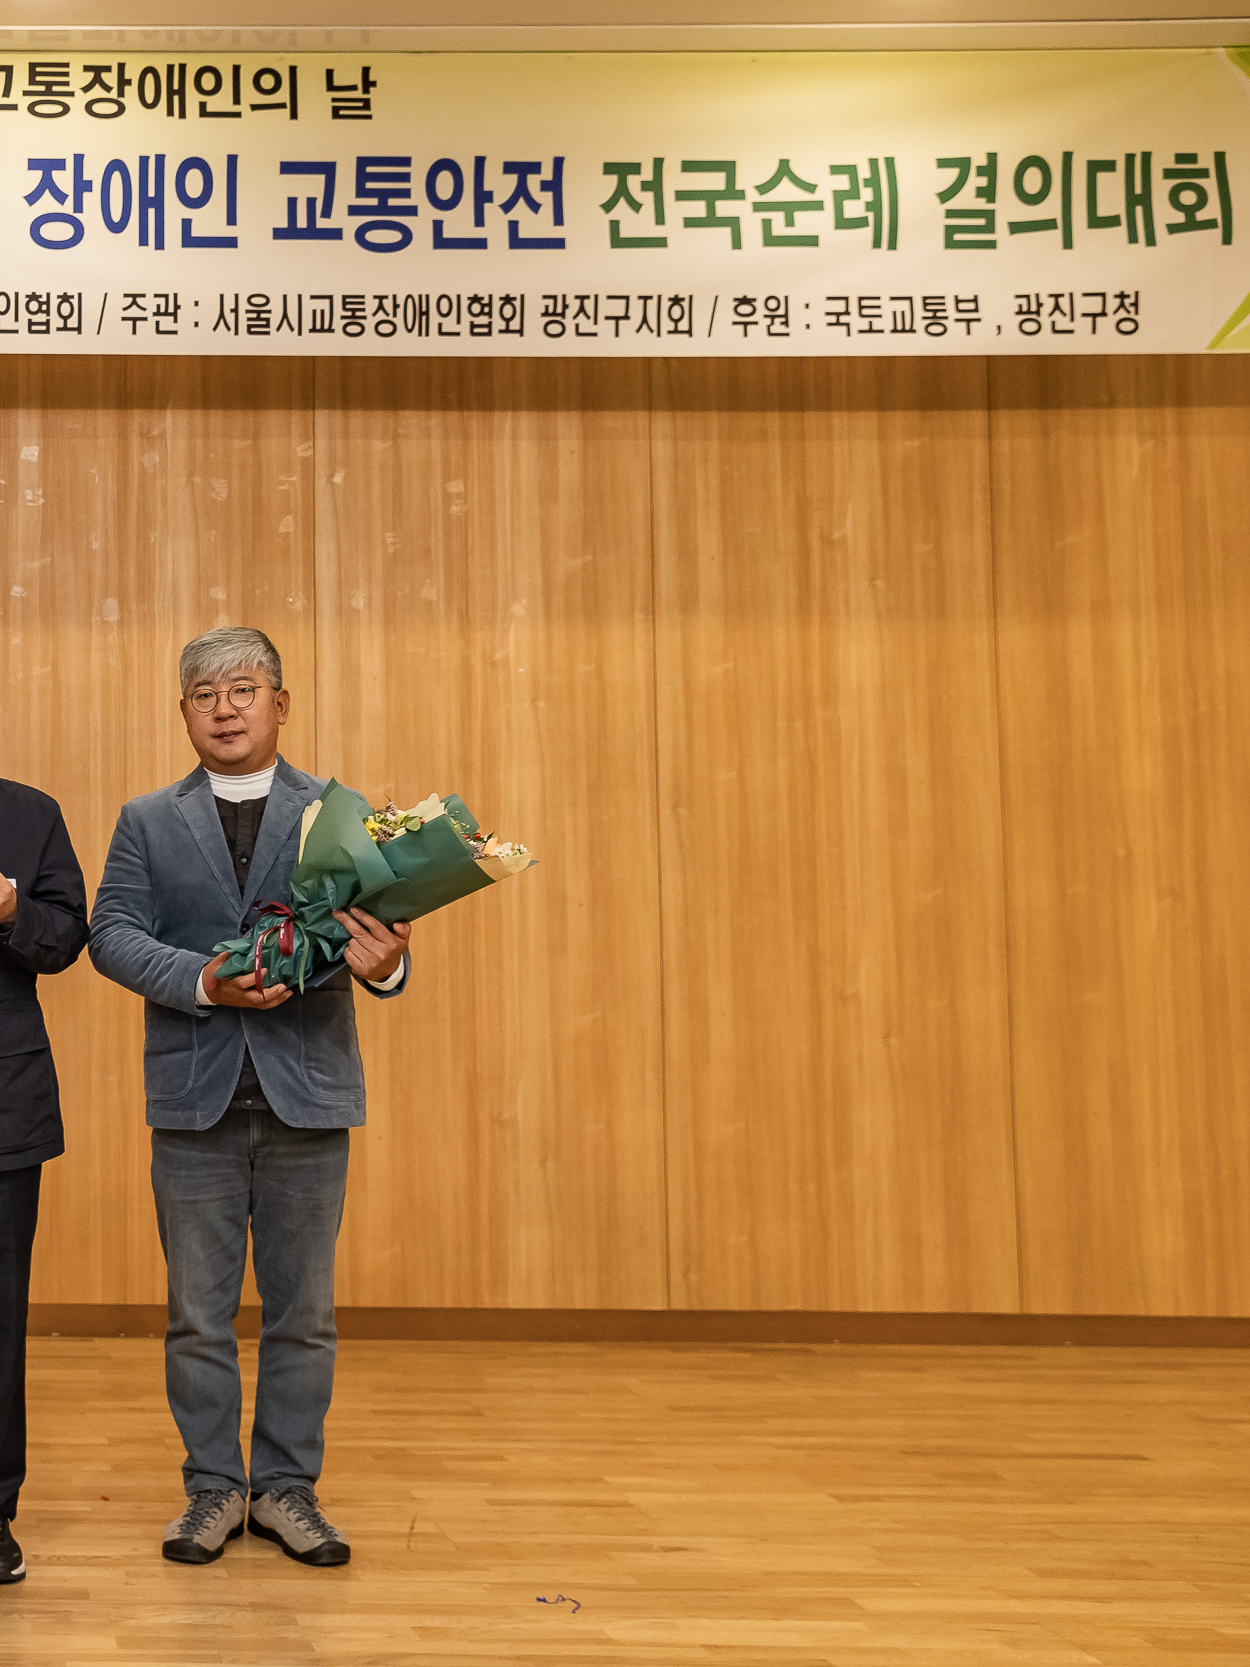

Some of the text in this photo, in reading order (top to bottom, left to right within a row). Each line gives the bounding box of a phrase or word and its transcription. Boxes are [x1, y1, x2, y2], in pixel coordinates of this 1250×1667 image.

[324, 66, 378, 121] 날
[22, 153, 239, 251] 장애인
[271, 156, 567, 253] 교통안전
[598, 157, 899, 252] 전국순례
[935, 151, 1234, 251] 결의대회
[120, 293, 182, 336] 주관
[211, 293, 526, 339] 서울시교통장애인협회
[539, 294, 694, 339] 광진구지회
[731, 295, 791, 339] 후원
[823, 294, 983, 338] 국토교통부
[1013, 290, 1141, 337] 광진구청
